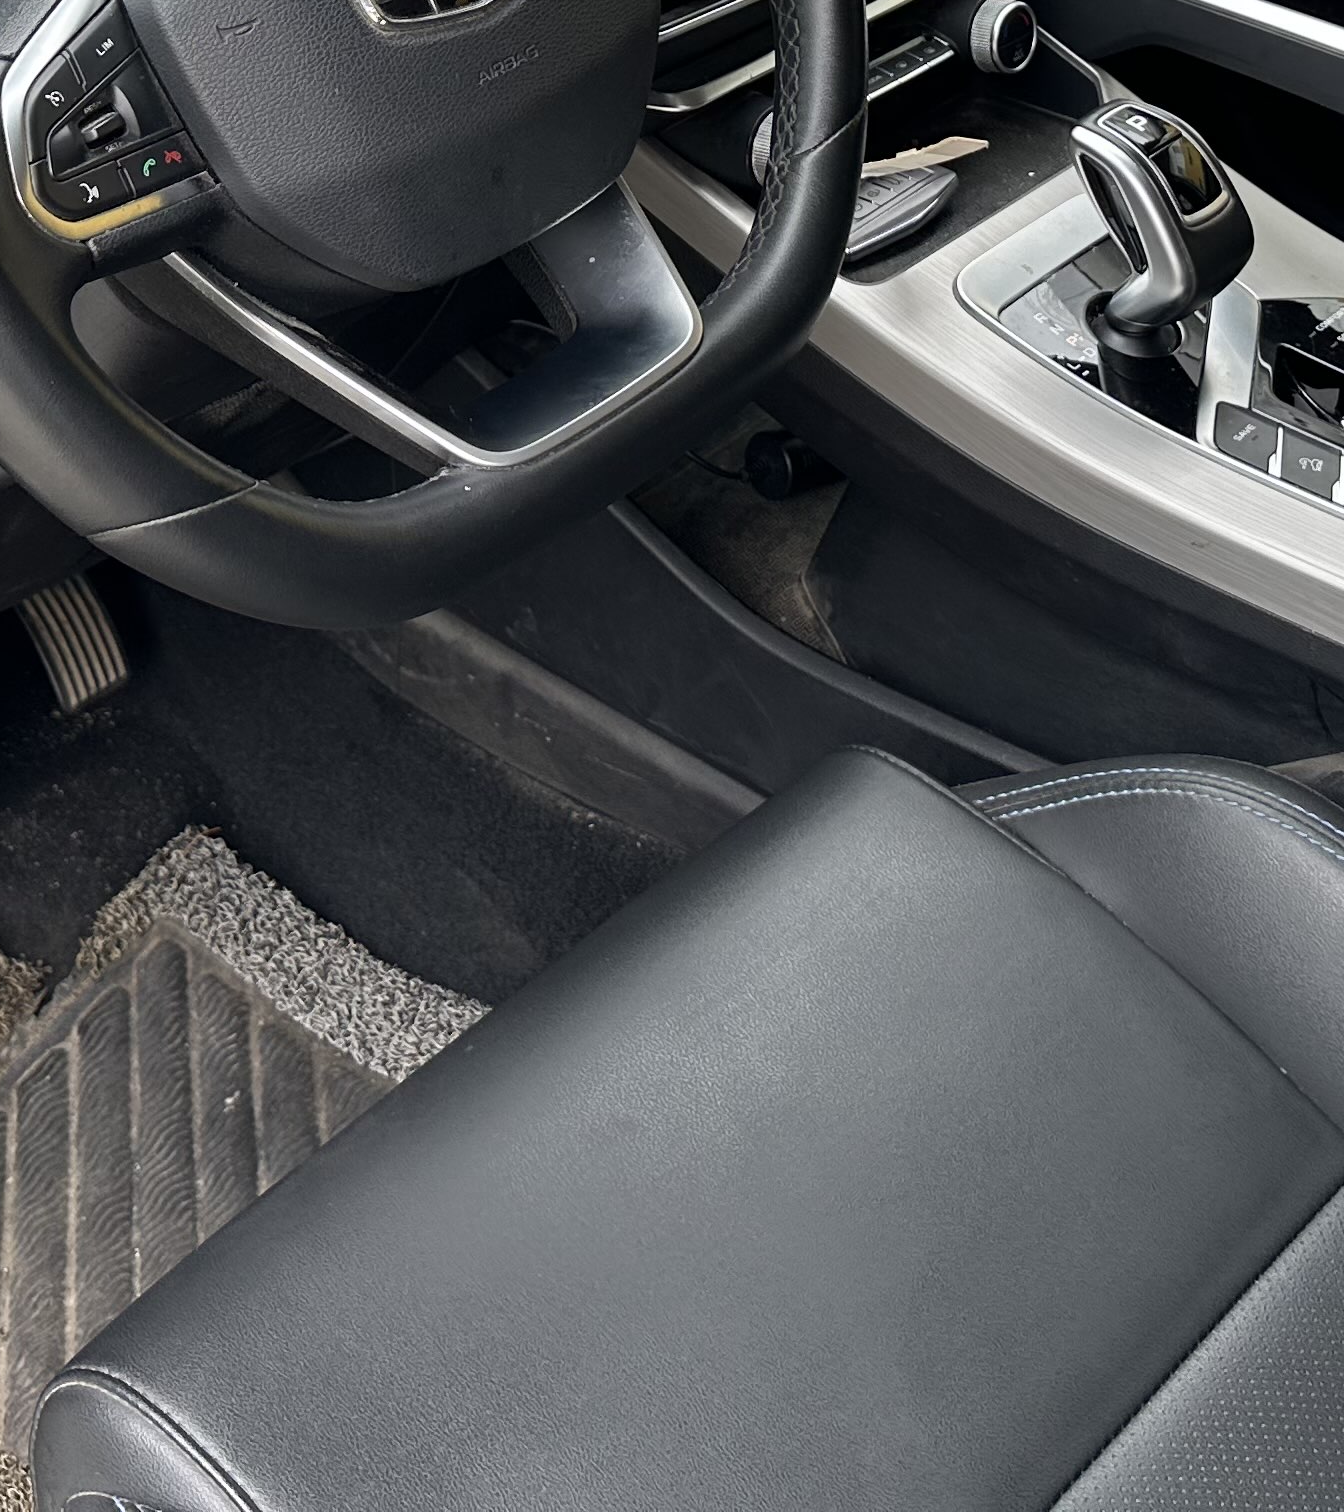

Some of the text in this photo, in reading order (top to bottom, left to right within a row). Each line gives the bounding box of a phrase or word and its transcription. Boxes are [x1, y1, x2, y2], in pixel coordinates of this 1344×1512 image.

[96, 38, 115, 56] LIM
[479, 44, 539, 85] AIRBAG
[1126, 114, 1148, 132] P
[1049, 324, 1064, 335] N
[1233, 423, 1256, 442] SAVE
